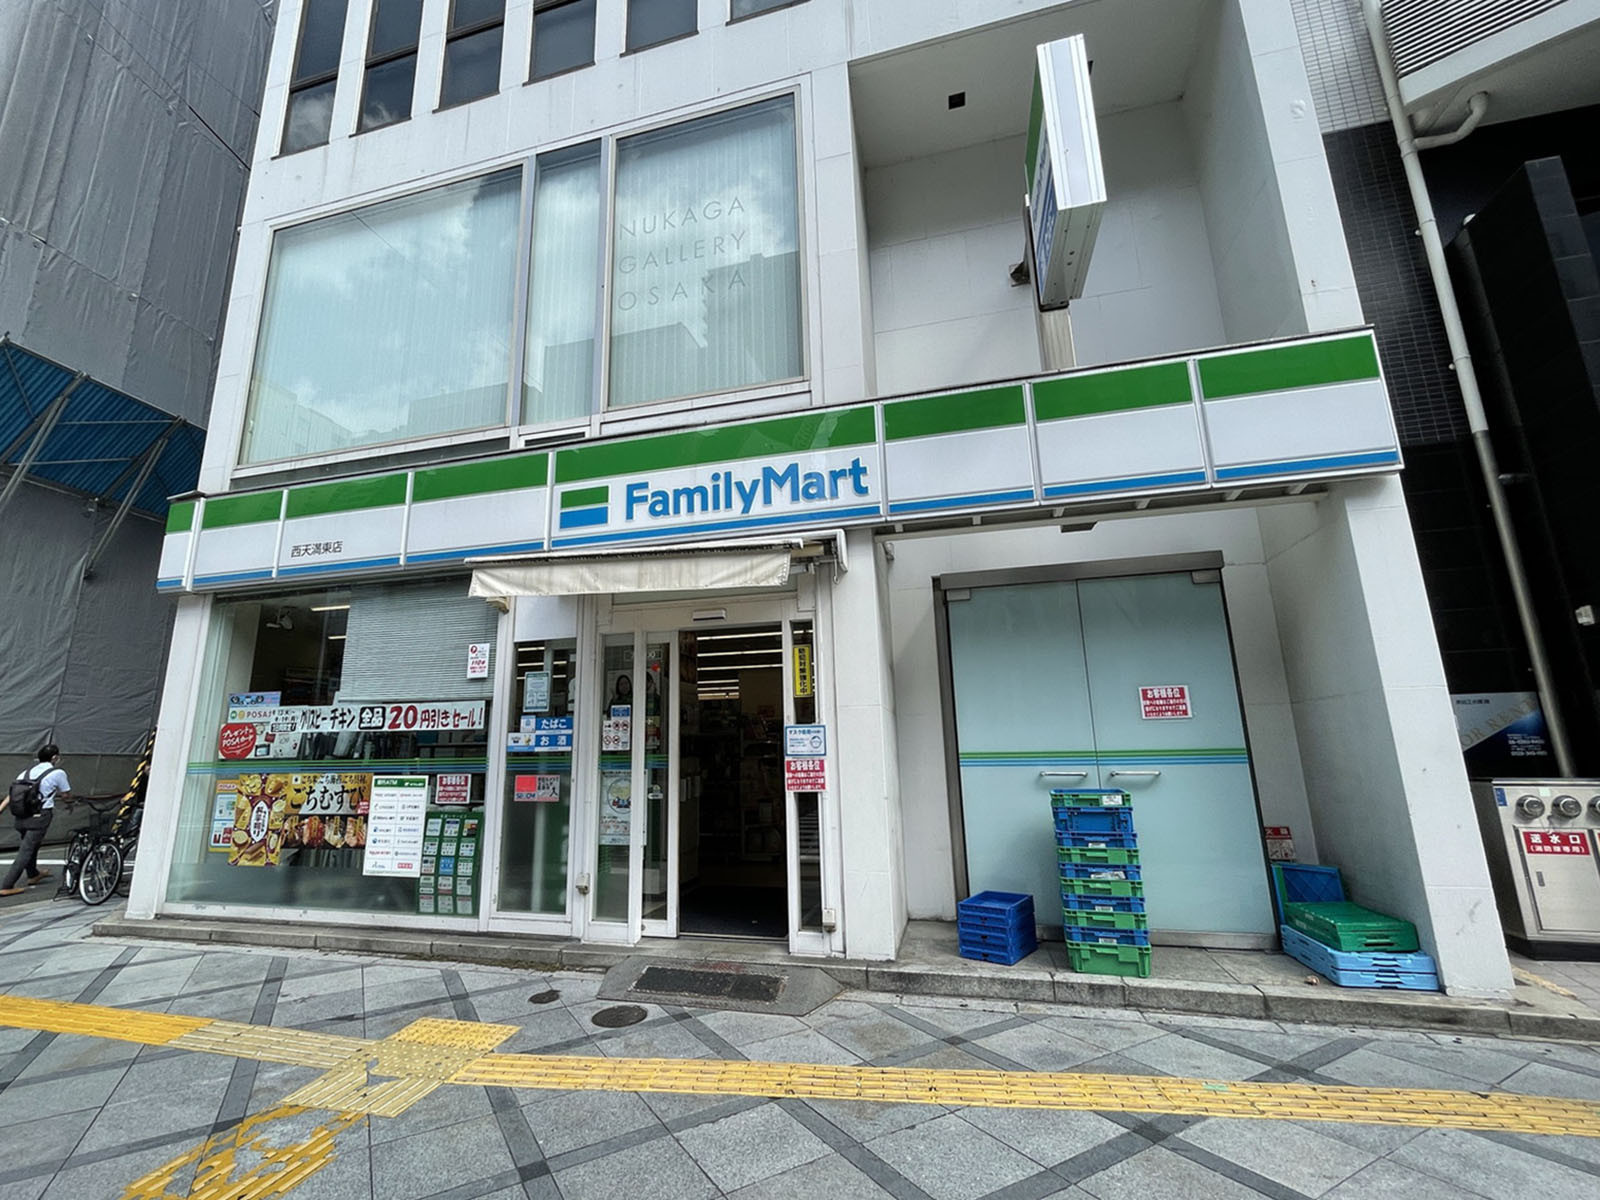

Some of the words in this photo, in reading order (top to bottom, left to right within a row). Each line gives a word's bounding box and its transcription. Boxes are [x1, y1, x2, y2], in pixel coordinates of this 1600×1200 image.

[619, 197, 745, 240] NUKAGA
[619, 232, 746, 274] GALLERY
[618, 270, 747, 311] OSAKA
[625, 456, 869, 521] FamilyMart
[290, 540, 344, 558] 西天満東店
[361, 707, 386, 729] 全品
[540, 718, 567, 729] たばこ
[290, 785, 367, 813] ごちむすび
[1530, 833, 1581, 844] 送水口
